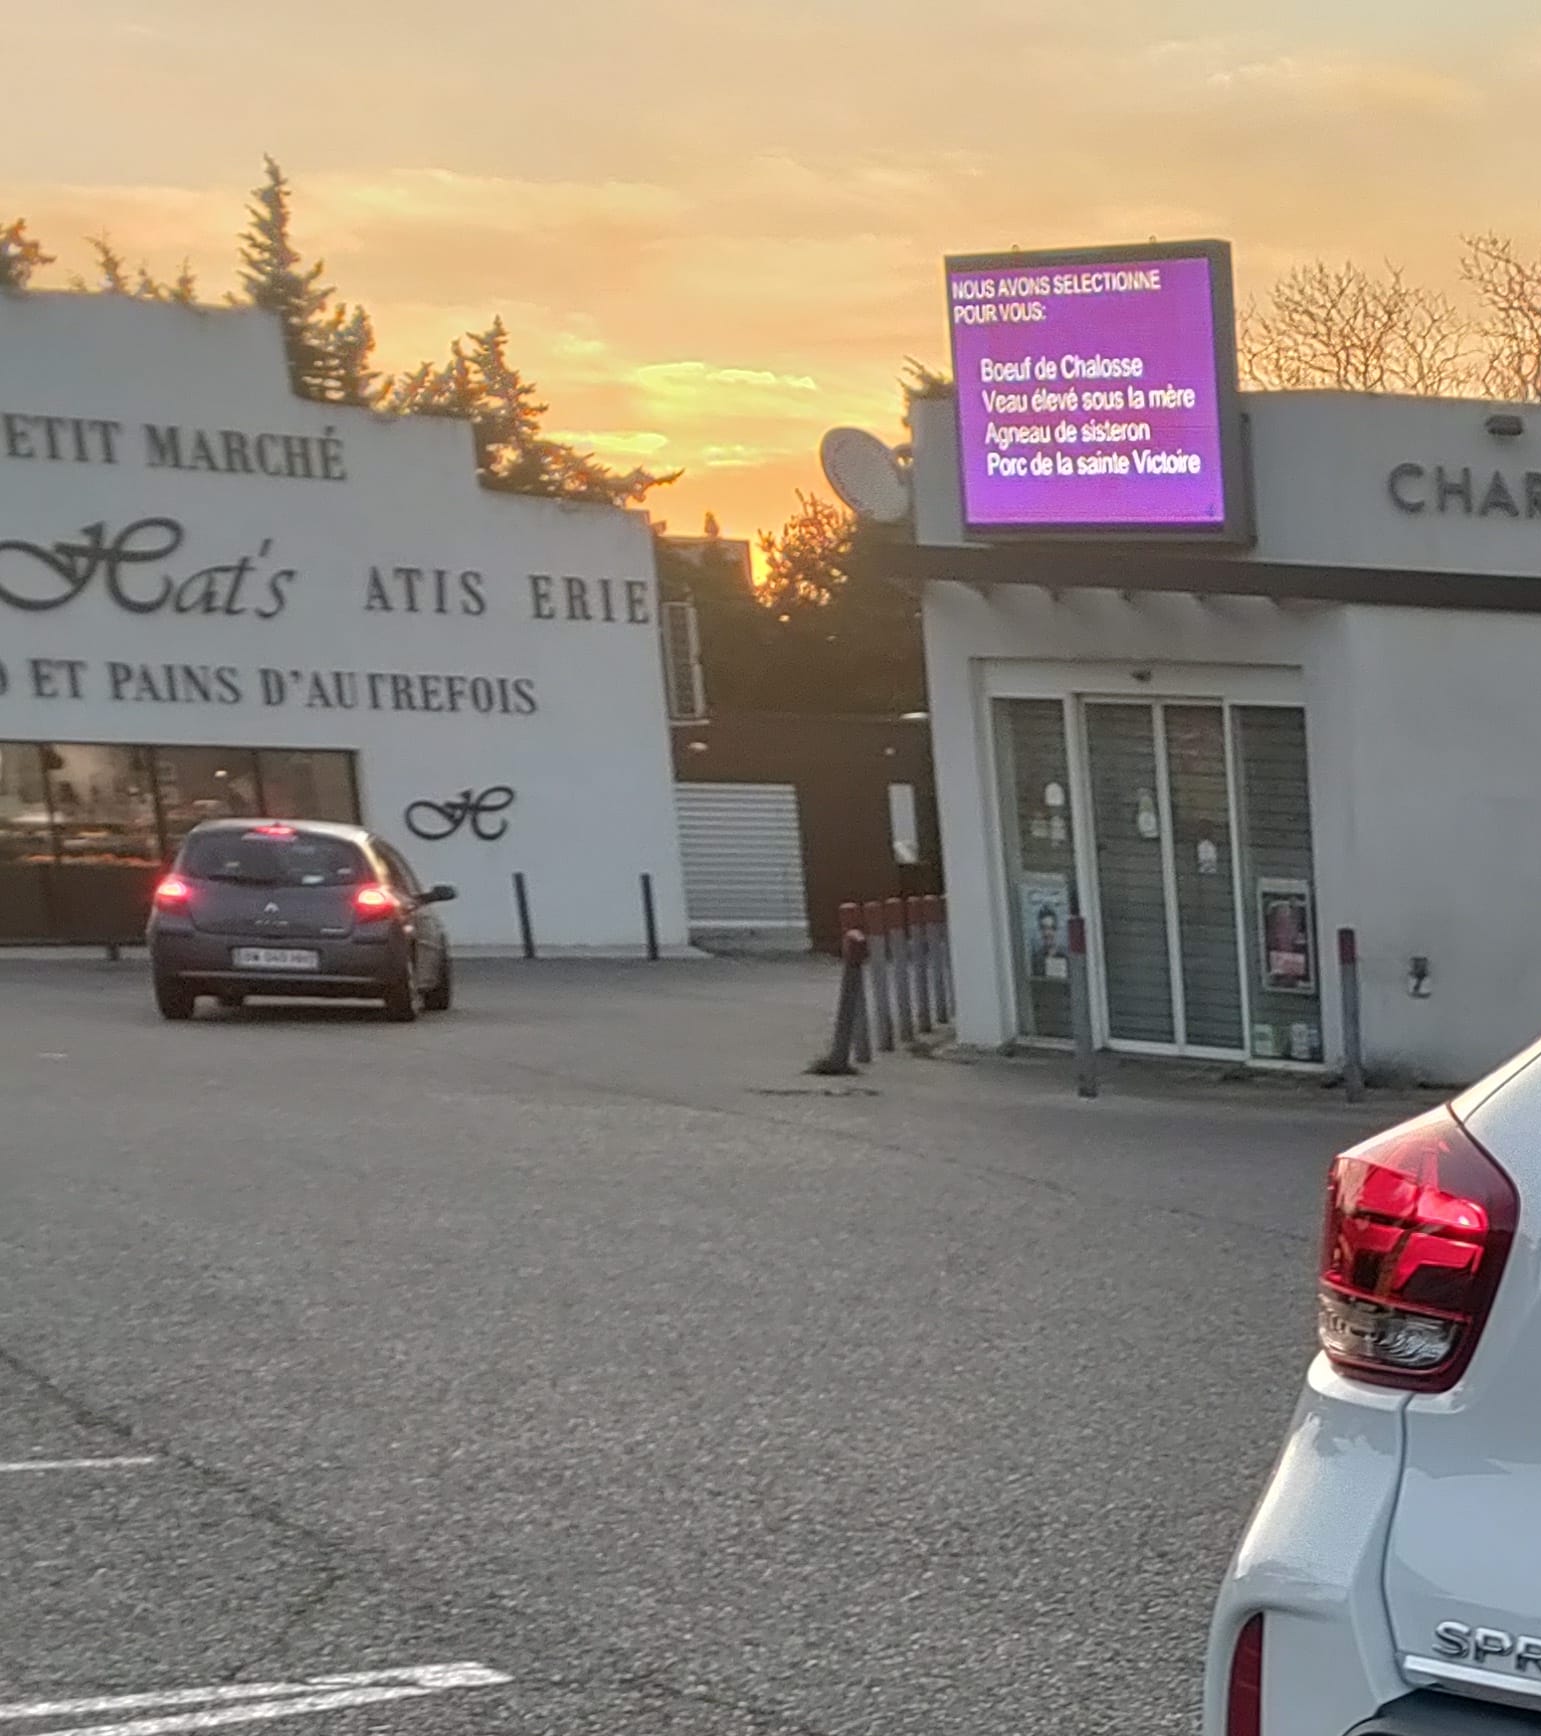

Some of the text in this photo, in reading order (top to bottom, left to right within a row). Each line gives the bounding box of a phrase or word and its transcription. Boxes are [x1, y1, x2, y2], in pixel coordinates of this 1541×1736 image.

[952, 269, 1161, 300] NOUS AVONS SELECTIONNE
[954, 301, 1047, 325] POUR VOUS:
[980, 354, 1143, 382] Boeuf de Chalosse
[982, 384, 1196, 414] Veau élevé sous la mère
[984, 418, 1151, 450] Agneau de sisteron
[143, 424, 348, 481] MARCHÉ
[987, 448, 1201, 476] Porc de la sainte Victoire
[28, 657, 88, 700] ET
[105, 660, 243, 705] PAINS
[257, 666, 540, 716] D'AUTREFOIS
